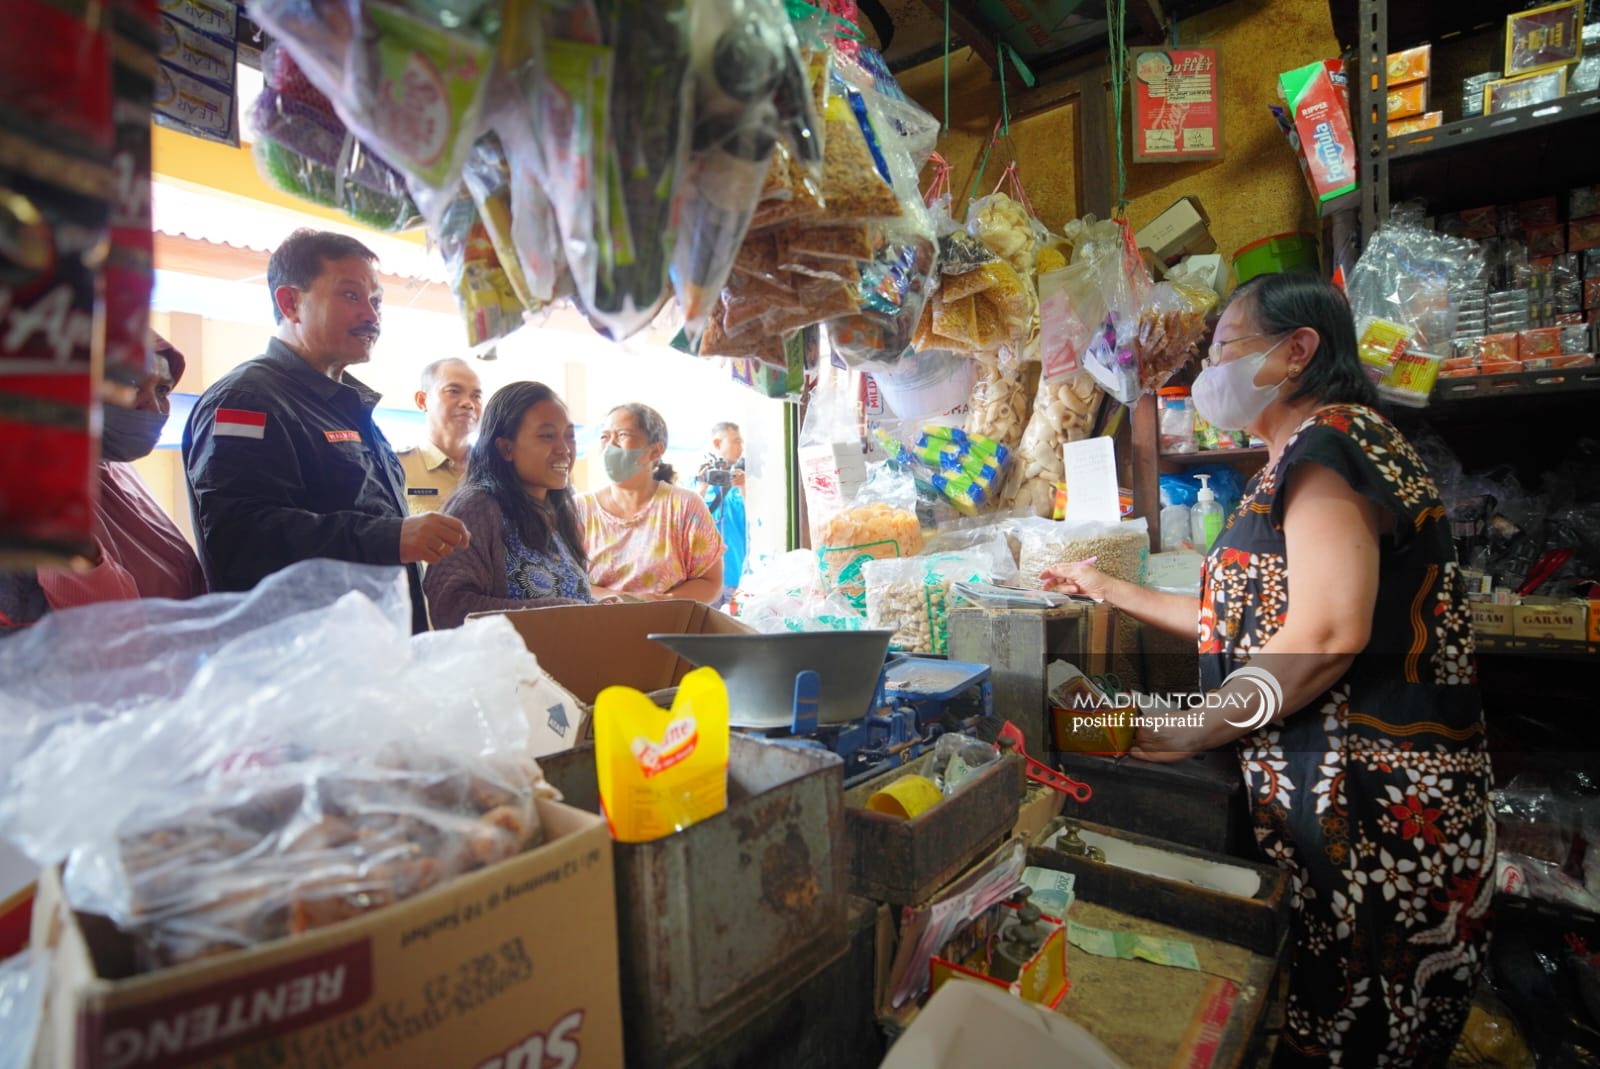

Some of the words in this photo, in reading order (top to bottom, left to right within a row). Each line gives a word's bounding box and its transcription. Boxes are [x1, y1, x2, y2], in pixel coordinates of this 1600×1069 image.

[1163, 62, 1213, 74] OUTLET
[177, 100, 225, 129] CLEAR
[1313, 121, 1347, 185] Formula
[1472, 613, 1505, 624] RAM
[1521, 615, 1575, 625] GARAM
[101, 964, 348, 1068] RENTENG
